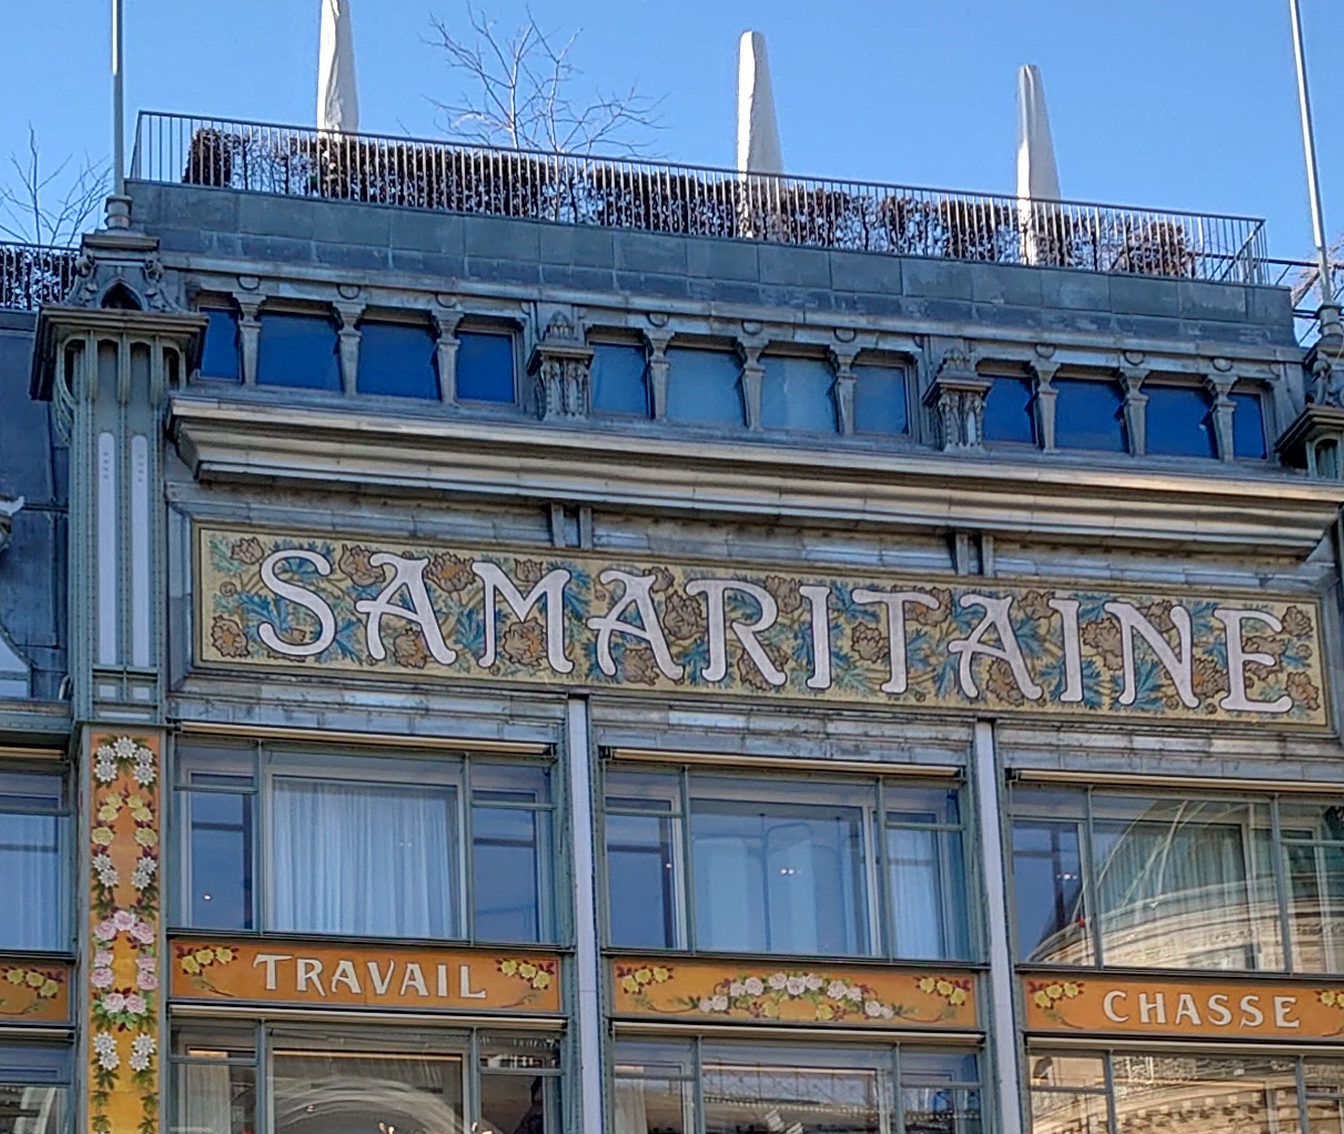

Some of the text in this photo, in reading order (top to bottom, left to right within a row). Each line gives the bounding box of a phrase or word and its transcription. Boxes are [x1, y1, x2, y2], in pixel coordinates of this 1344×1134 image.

[257, 548, 1294, 716] SAMARITAINE
[253, 954, 487, 999] TRAVAIL
[1103, 990, 1300, 1029] CHASSE
